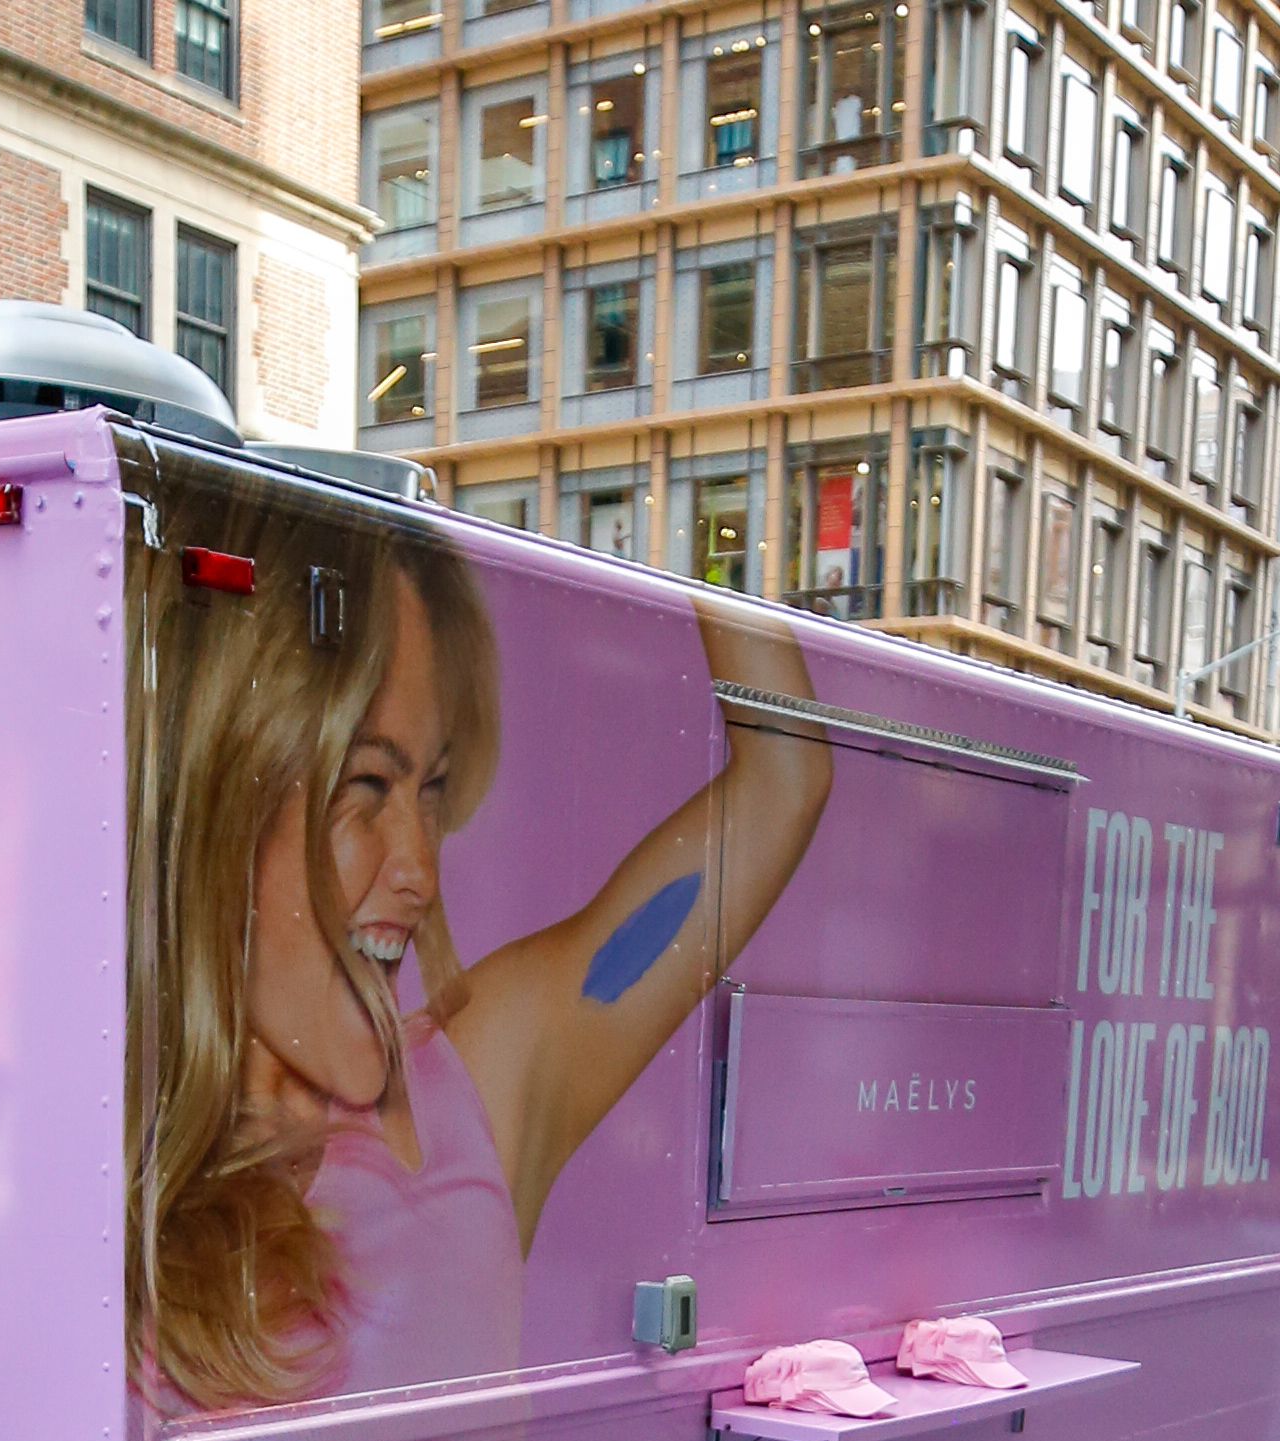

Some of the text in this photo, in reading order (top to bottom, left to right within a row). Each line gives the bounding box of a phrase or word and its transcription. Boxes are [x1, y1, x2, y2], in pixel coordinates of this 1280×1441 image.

[1077, 807, 1224, 1000] FOR THE
[857, 1072, 978, 1113] MAËLYS
[1062, 1019, 1270, 1200] LOVE OF BOD.
